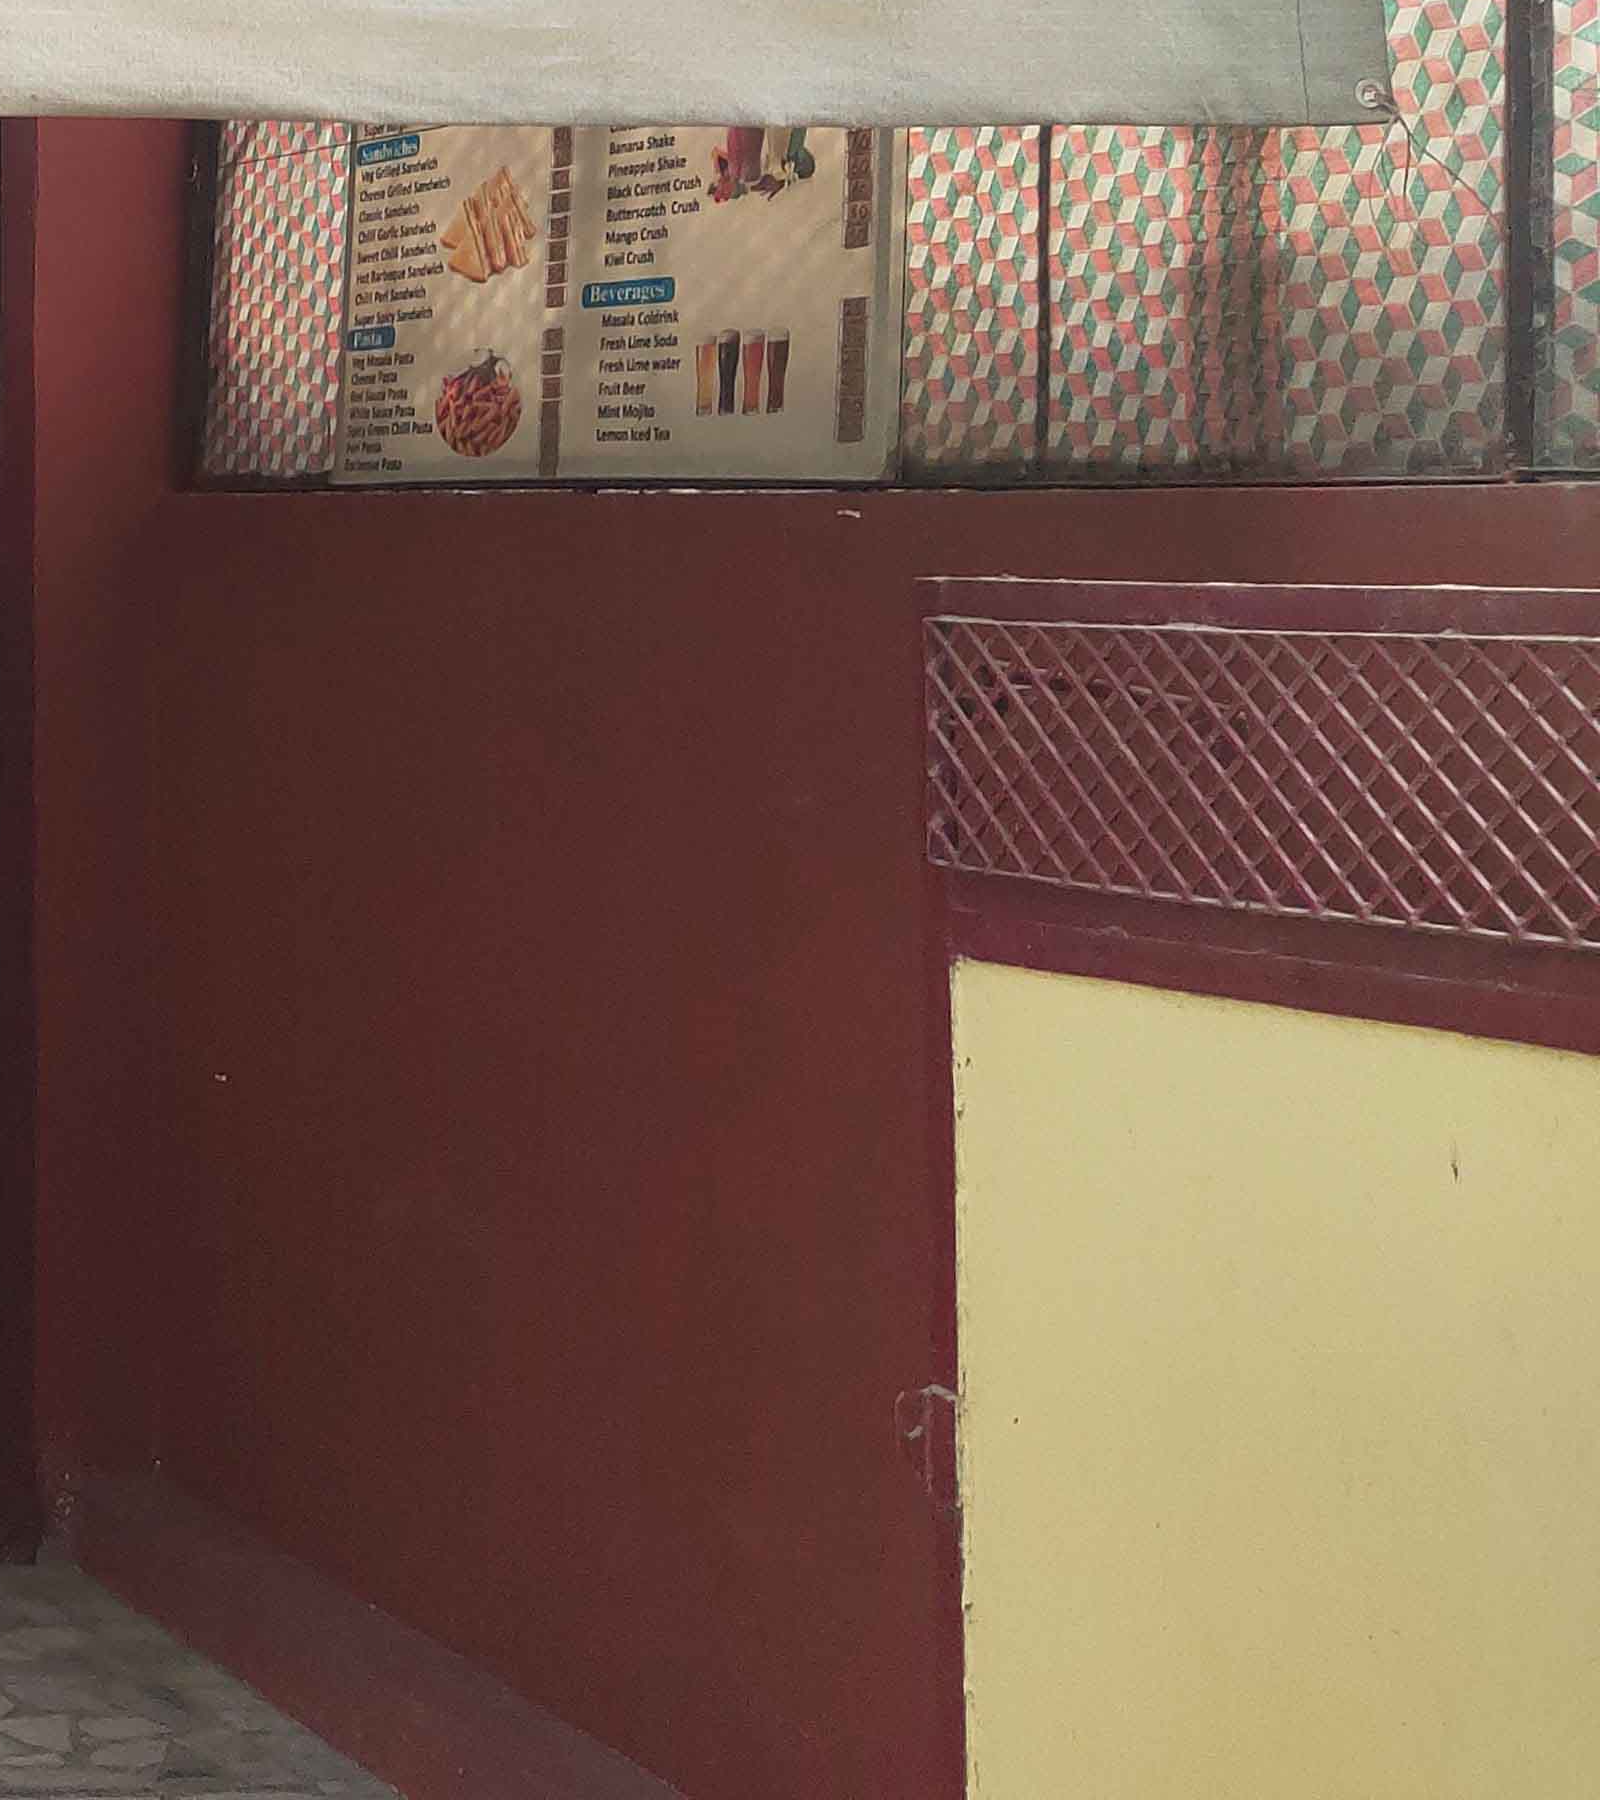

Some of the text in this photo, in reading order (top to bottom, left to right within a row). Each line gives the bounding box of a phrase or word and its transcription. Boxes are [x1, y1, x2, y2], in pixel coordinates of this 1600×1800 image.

[609, 134, 675, 155] Banana Shake
[402, 157, 438, 176] Sandwich
[608, 156, 687, 178] Pineapple Shake
[414, 176, 450, 193] Sandwich
[607, 175, 701, 200] Black Current Crush
[384, 202, 420, 219] Sandwich
[606, 198, 700, 222] Butterscotch Crush
[377, 223, 399, 241] Garlic
[400, 220, 437, 237] Sandwich
[605, 225, 668, 246] Mango Crush
[400, 242, 437, 259] Sandwich
[626, 249, 654, 265] Crush
[408, 261, 444, 279] Sandwich
[390, 285, 426, 301] Sandwich
[590, 283, 665, 303] Beverages
[396, 306, 432, 321] Sandwich
[602, 310, 679, 327] Masala Coldrink
[601, 333, 678, 351] Fresh Lime Soda
[394, 352, 414, 366] Pasta
[600, 357, 680, 374] Fresh Lime water
[378, 370, 397, 383] Pasta
[599, 381, 645, 396] Fruit Beer
[394, 403, 415, 417] Pasta
[598, 404, 655, 421] Mint Mojito
[412, 419, 432, 434] Pasta
[596, 426, 670, 442] Lemon Iced Tea
